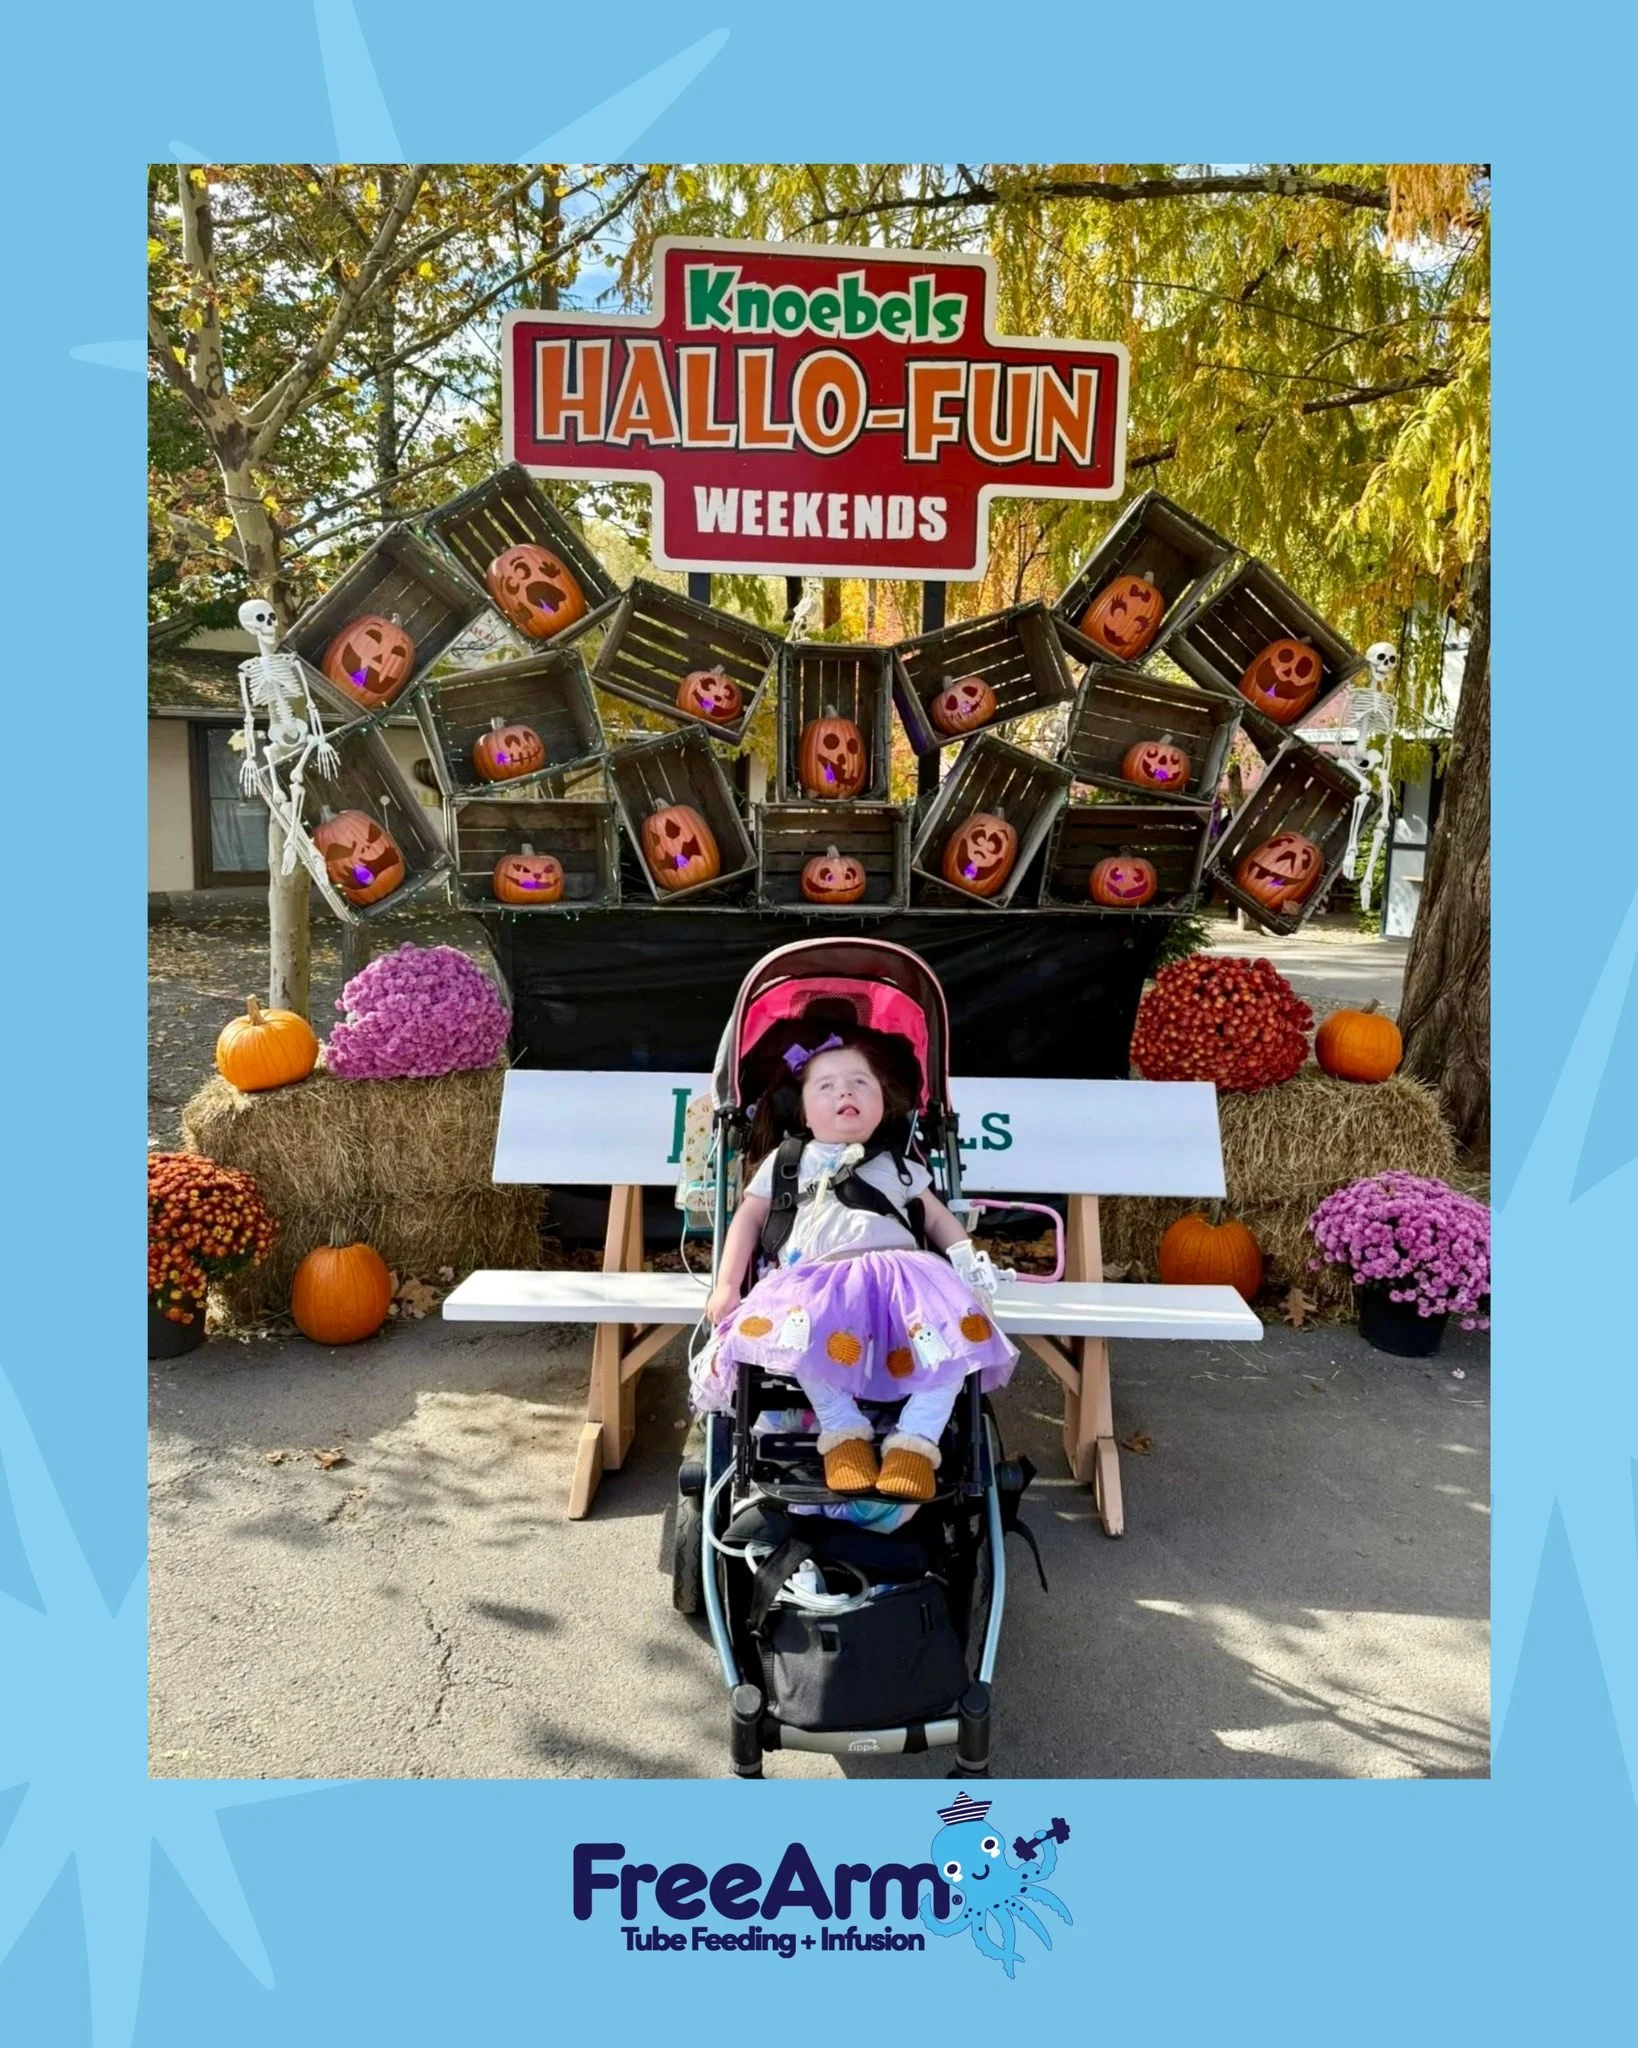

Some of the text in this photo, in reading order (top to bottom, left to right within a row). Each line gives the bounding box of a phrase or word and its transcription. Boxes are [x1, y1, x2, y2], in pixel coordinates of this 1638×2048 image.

[684, 263, 969, 343] Knoebels
[532, 338, 1099, 467] HALLO-FUN
[693, 486, 948, 542] WEEKENDS
